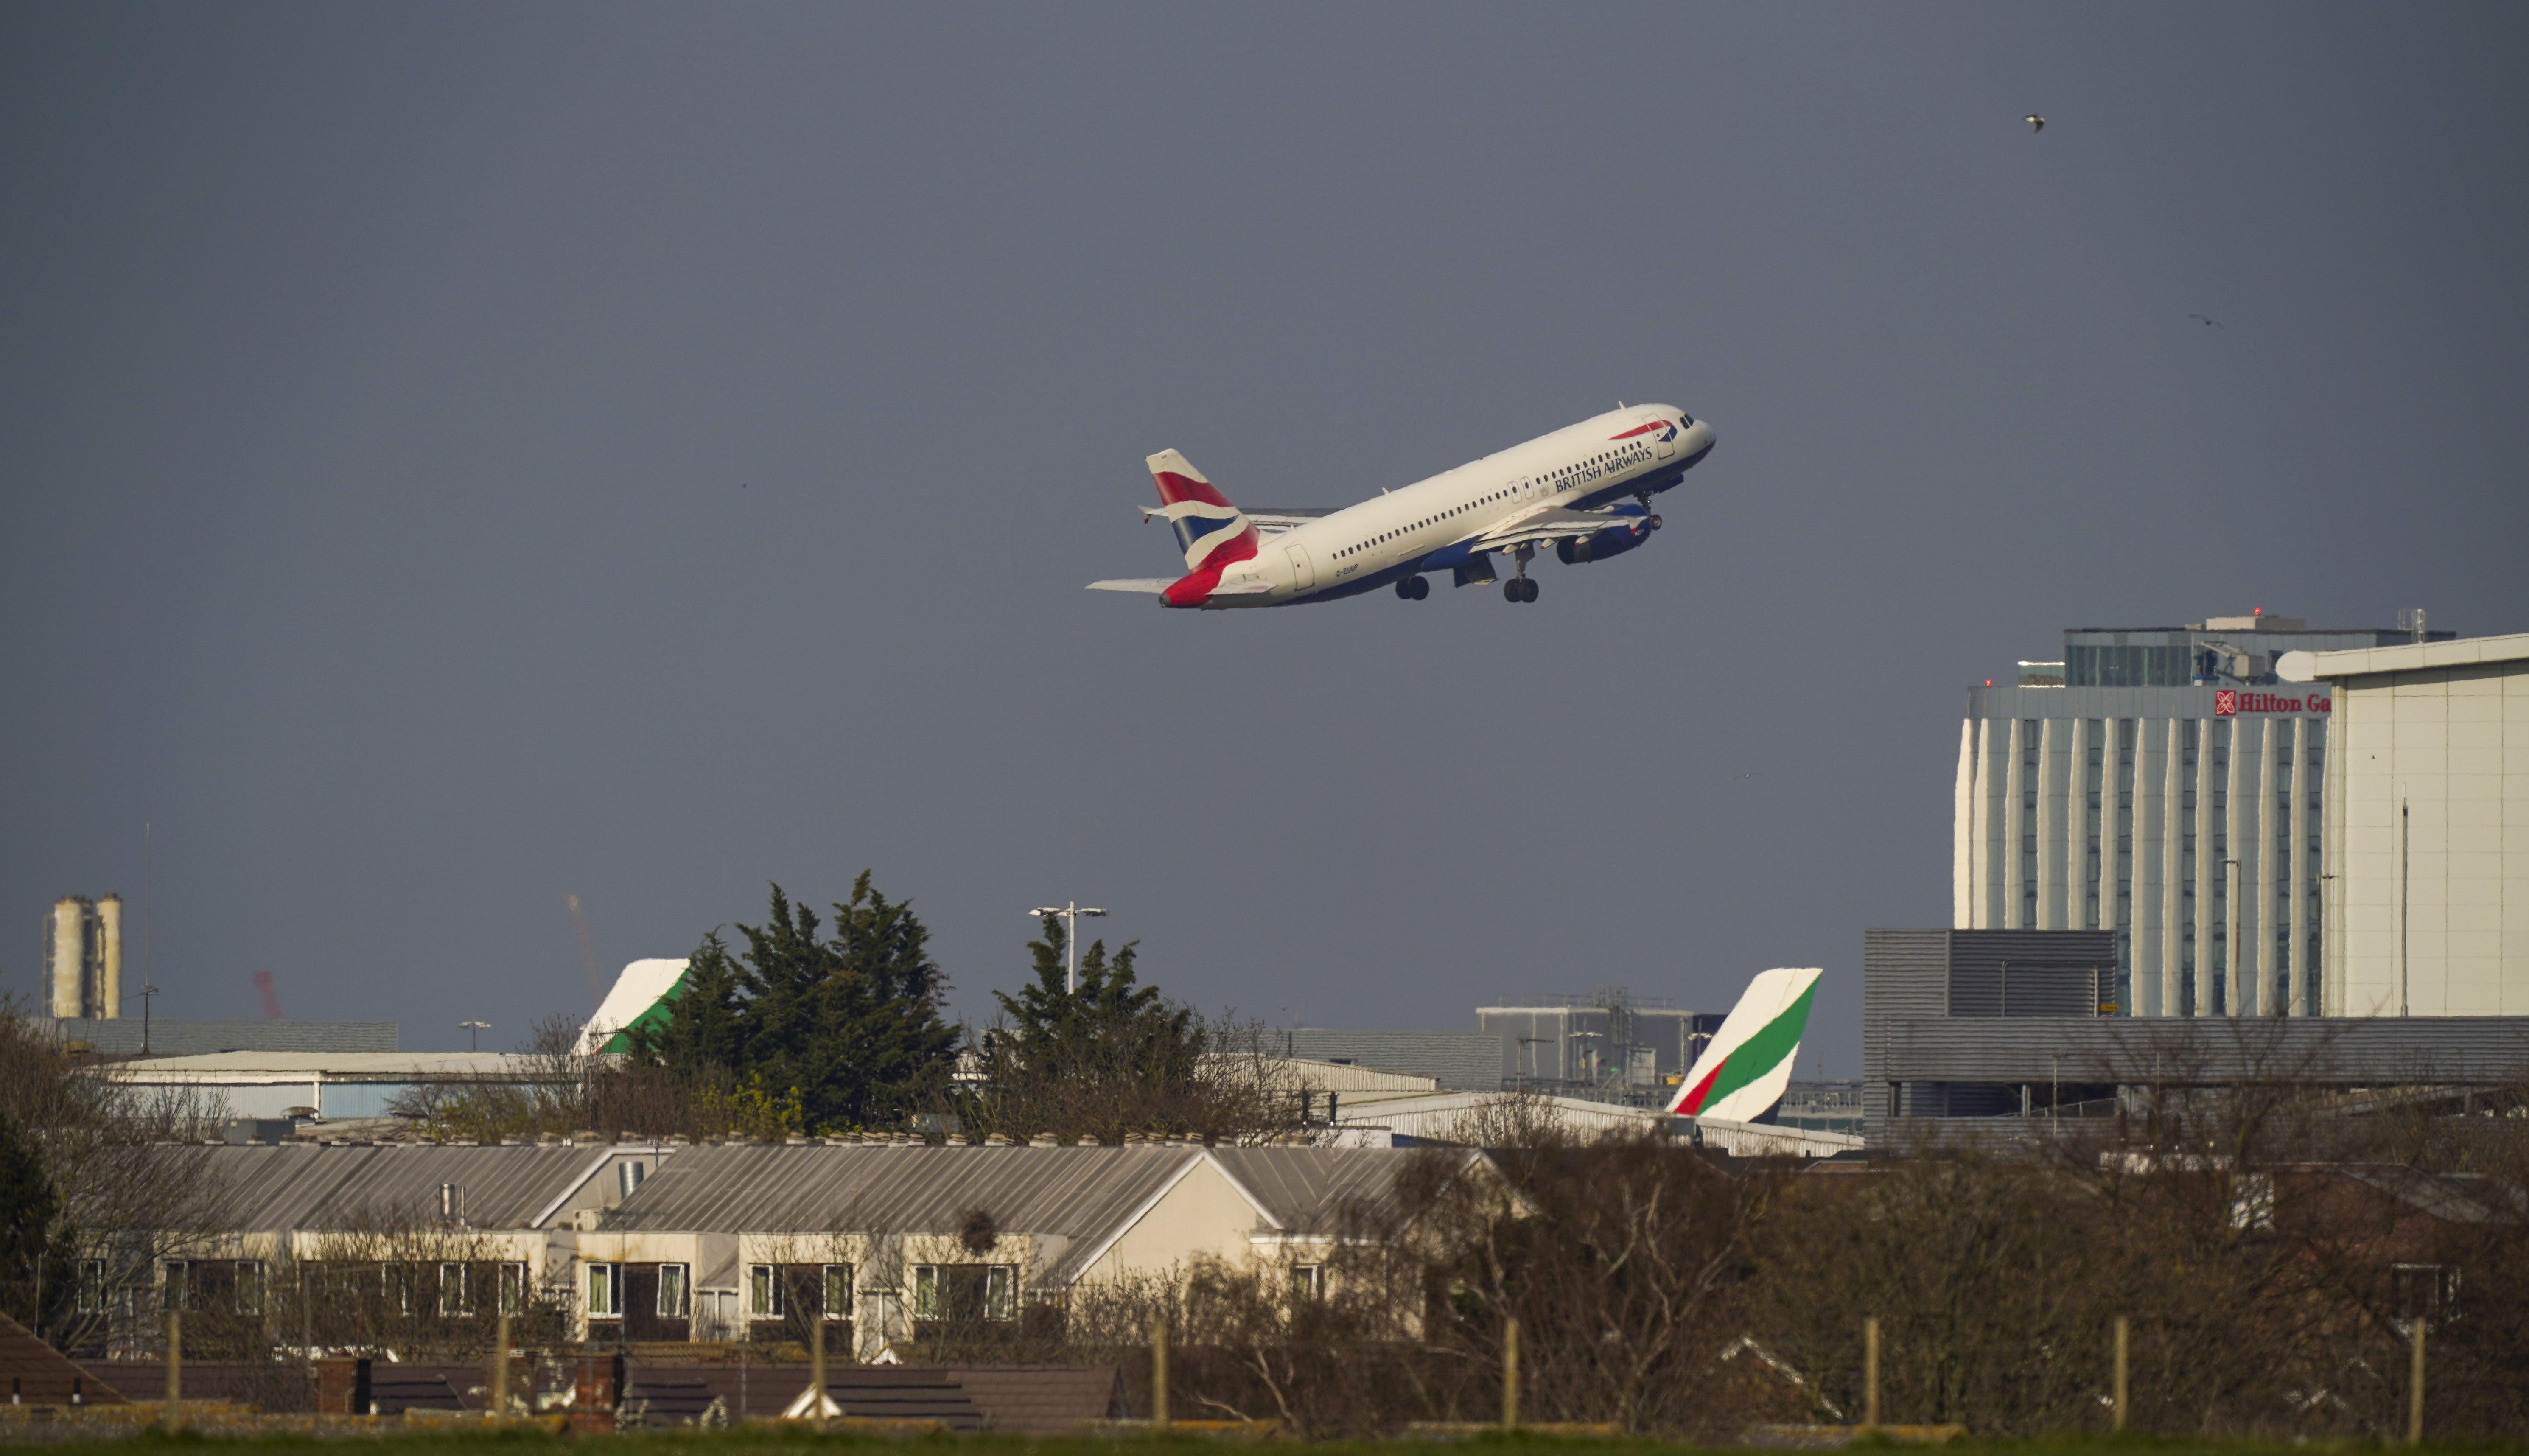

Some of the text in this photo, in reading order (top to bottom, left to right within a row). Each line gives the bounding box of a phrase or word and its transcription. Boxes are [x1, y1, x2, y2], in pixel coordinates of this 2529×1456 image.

[1555, 446, 1652, 493] BRITISH AIRWAYS
[2238, 693, 2302, 712] Hilton
